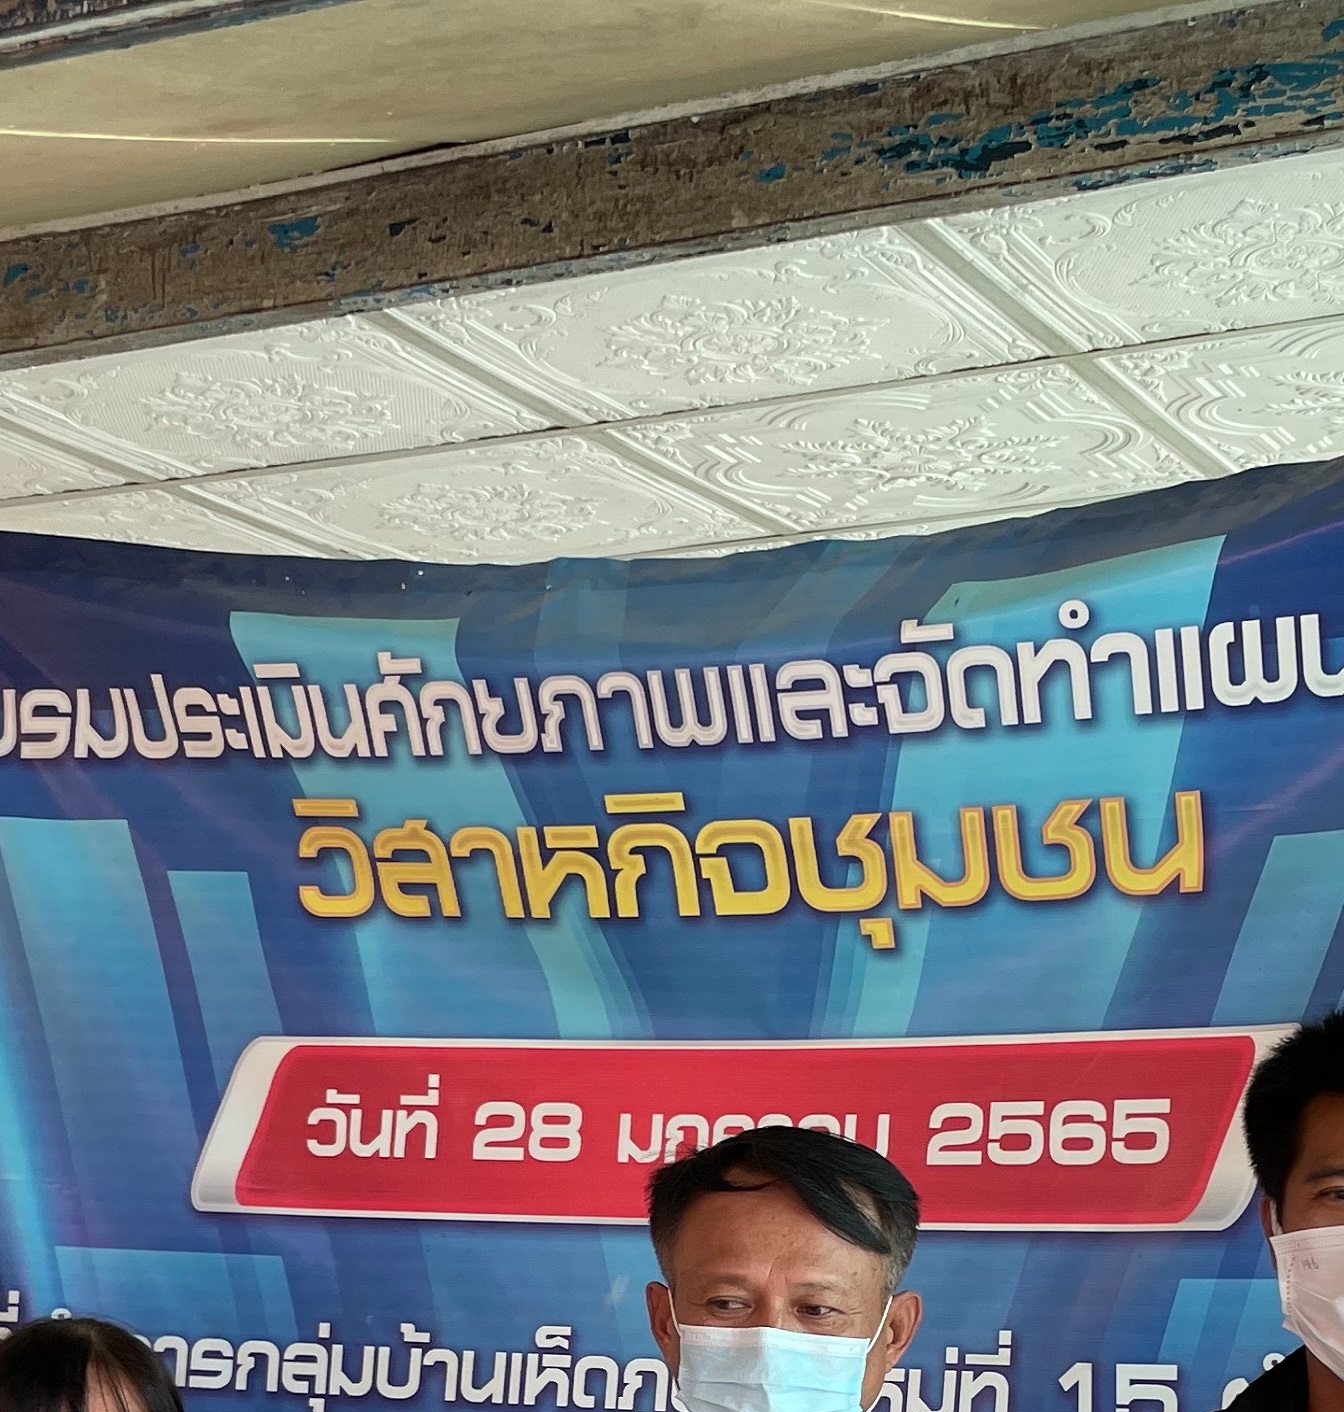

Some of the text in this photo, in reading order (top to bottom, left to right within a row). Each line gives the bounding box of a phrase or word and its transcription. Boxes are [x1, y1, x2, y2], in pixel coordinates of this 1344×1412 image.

[292, 790, 1206, 950] วิสาหกิจชุมชน
[306, 1074, 441, 1160] วันที่
[471, 1101, 583, 1163] 28
[925, 1098, 1172, 1166] 2565
